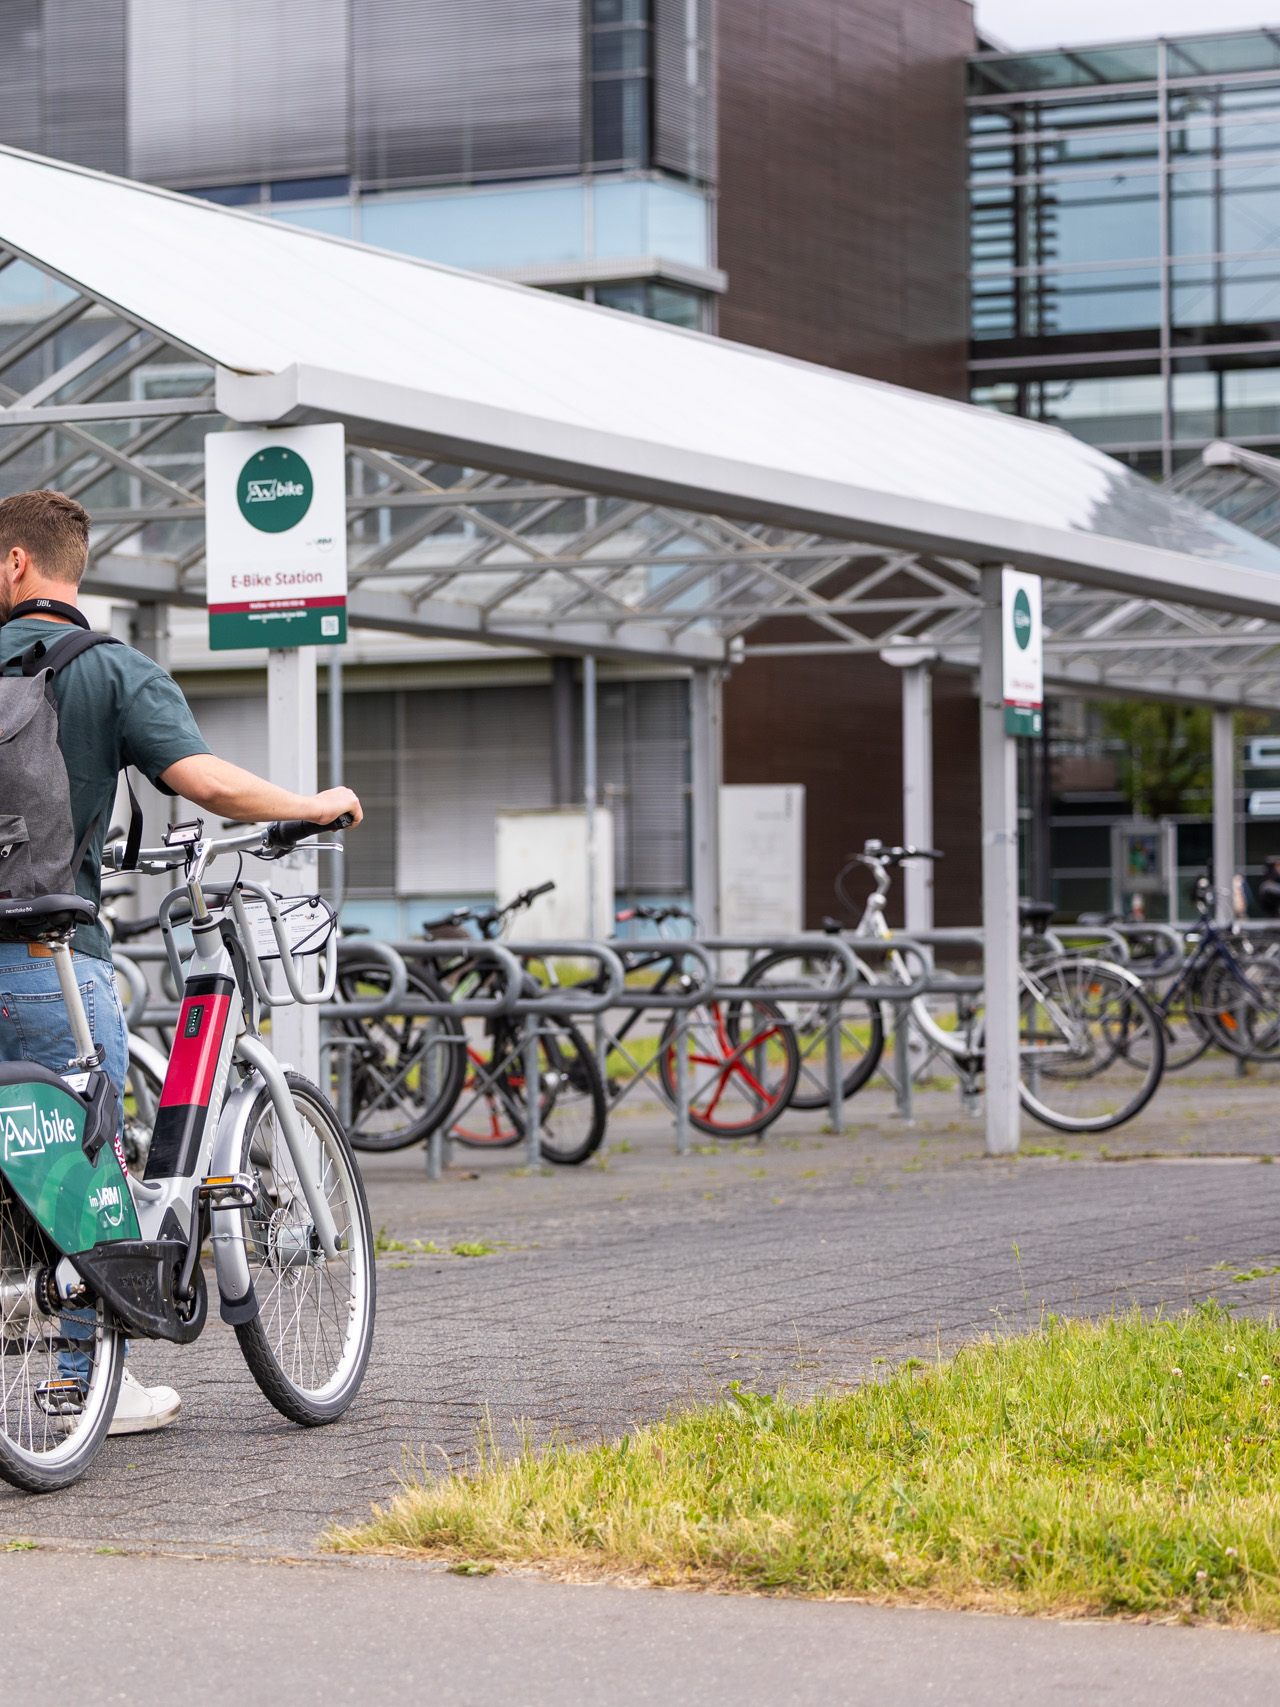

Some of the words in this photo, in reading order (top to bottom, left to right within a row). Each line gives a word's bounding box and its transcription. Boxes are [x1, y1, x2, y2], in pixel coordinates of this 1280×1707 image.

[231, 573, 271, 588] E-Bike
[275, 570, 323, 586] Station
[39, 1108, 77, 1145] bike
[88, 1194, 99, 1208] im
[96, 1186, 120, 1206] VRM
